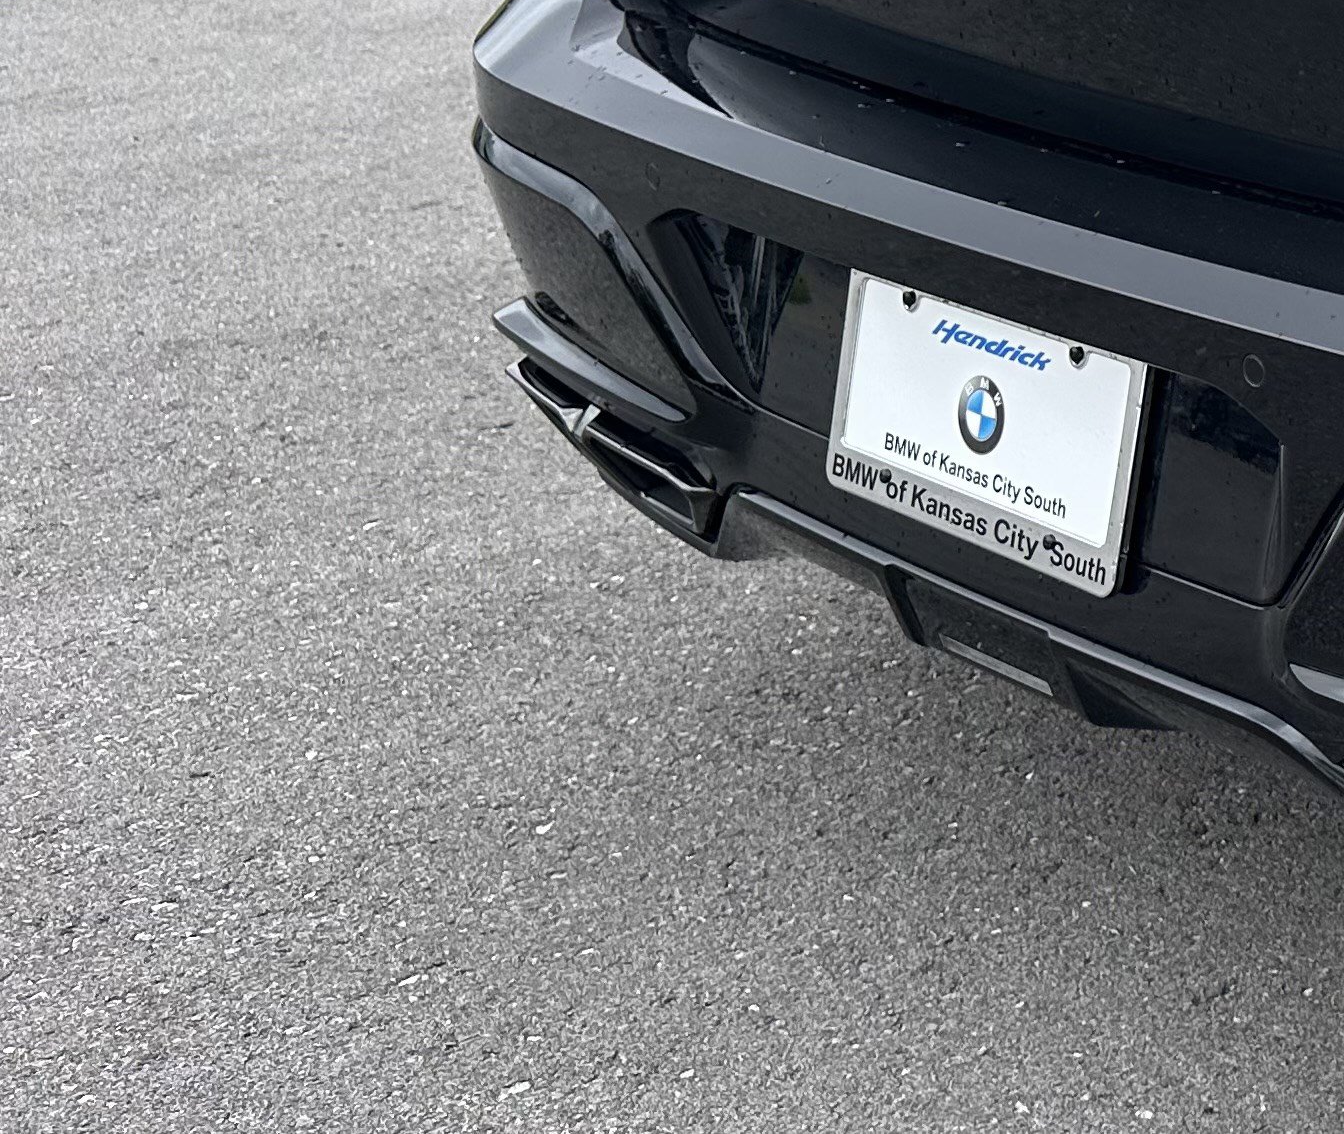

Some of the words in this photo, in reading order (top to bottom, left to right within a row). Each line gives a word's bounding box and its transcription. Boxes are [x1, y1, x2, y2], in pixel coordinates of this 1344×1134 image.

[931, 319, 1051, 371] Hendrick
[964, 376, 1003, 407] BMW
[885, 432, 920, 461] BMW
[923, 451, 937, 467] of
[939, 454, 989, 489] Kansas
[992, 474, 1020, 500] City
[1024, 486, 1066, 519] South
[832, 453, 877, 491] BMW
[886, 478, 907, 501] of
[911, 484, 988, 535] Kansas
[993, 518, 1039, 560] City
[1050, 539, 1106, 585] South
